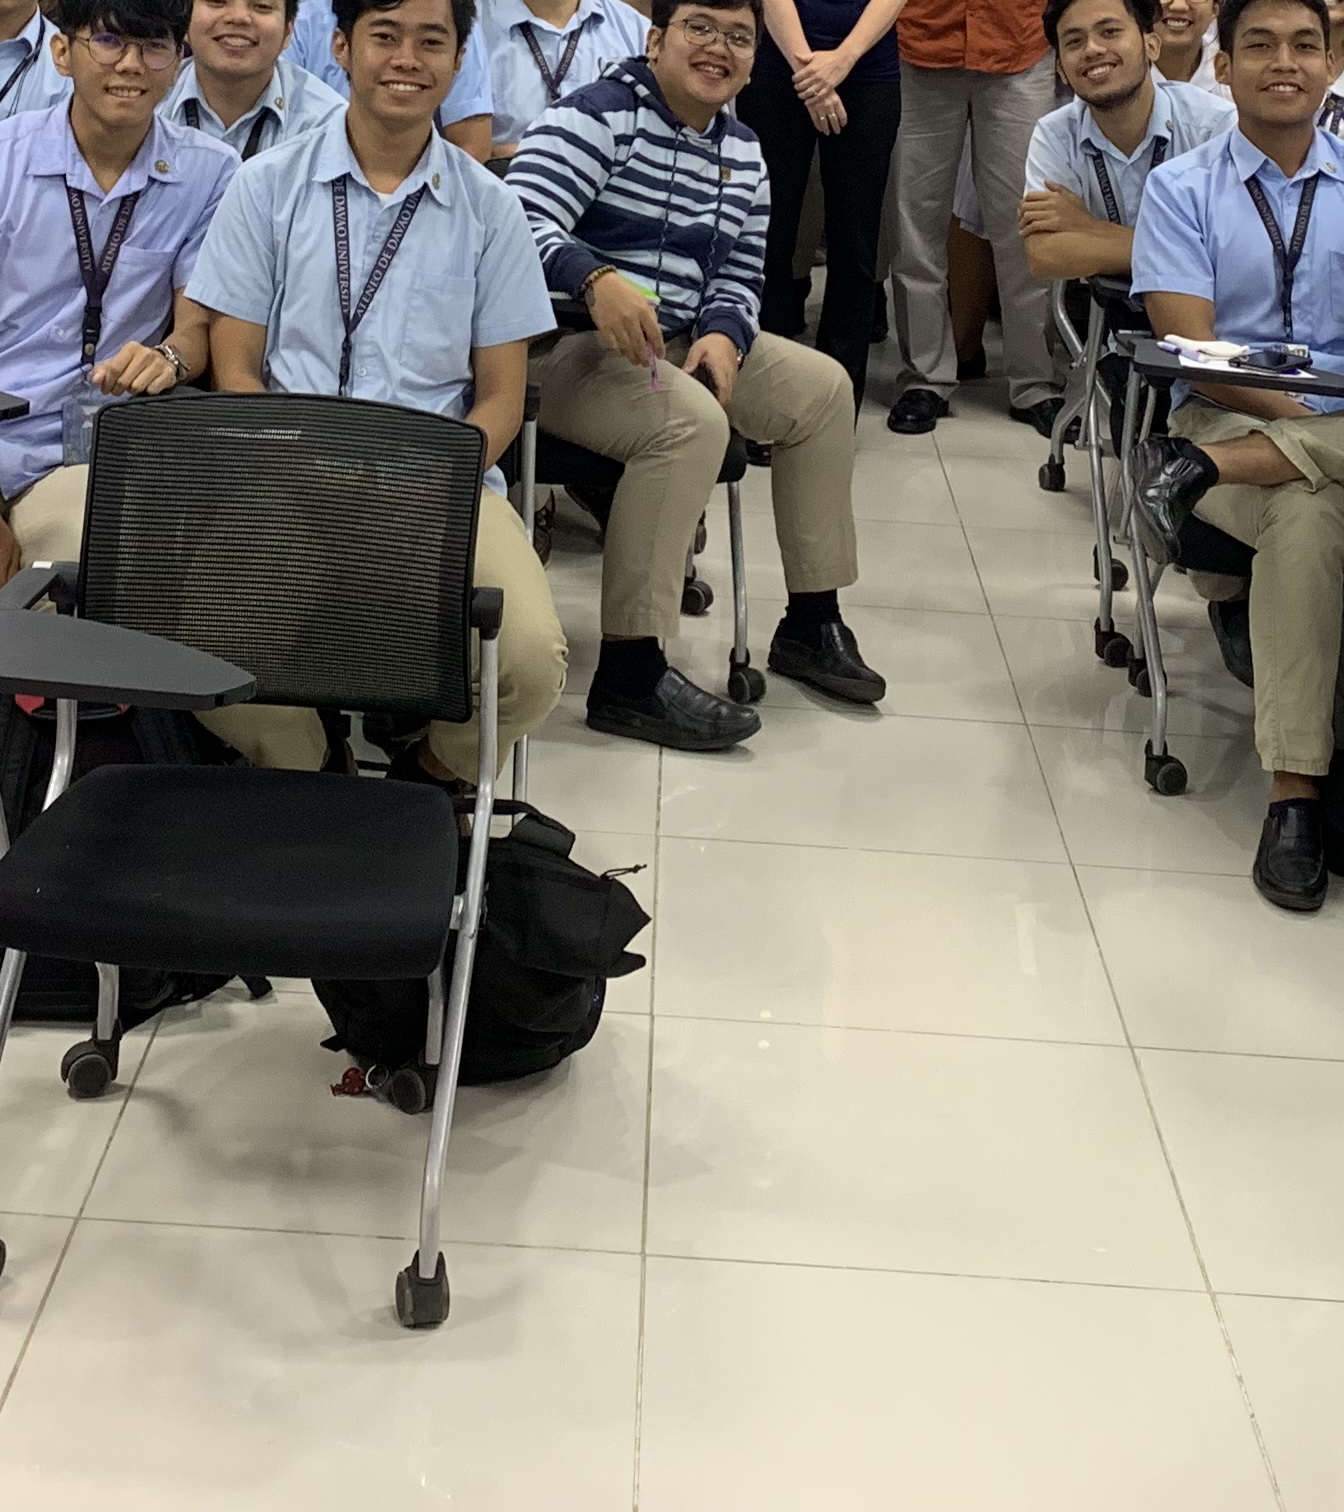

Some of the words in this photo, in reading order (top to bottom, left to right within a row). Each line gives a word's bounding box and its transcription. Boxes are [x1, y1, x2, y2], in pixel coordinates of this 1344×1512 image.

[1093, 158, 1110, 193] DAVAO
[71, 208, 94, 272] UNIVERSITY
[99, 231, 121, 274] ATENEO
[114, 215, 127, 231] DE
[334, 195, 346, 237] DAVAO
[337, 240, 349, 313] UNIVERSITY
[352, 268, 384, 317] ATENEO
[376, 250, 389, 267] DE
[385, 208, 413, 250] DAVAO
